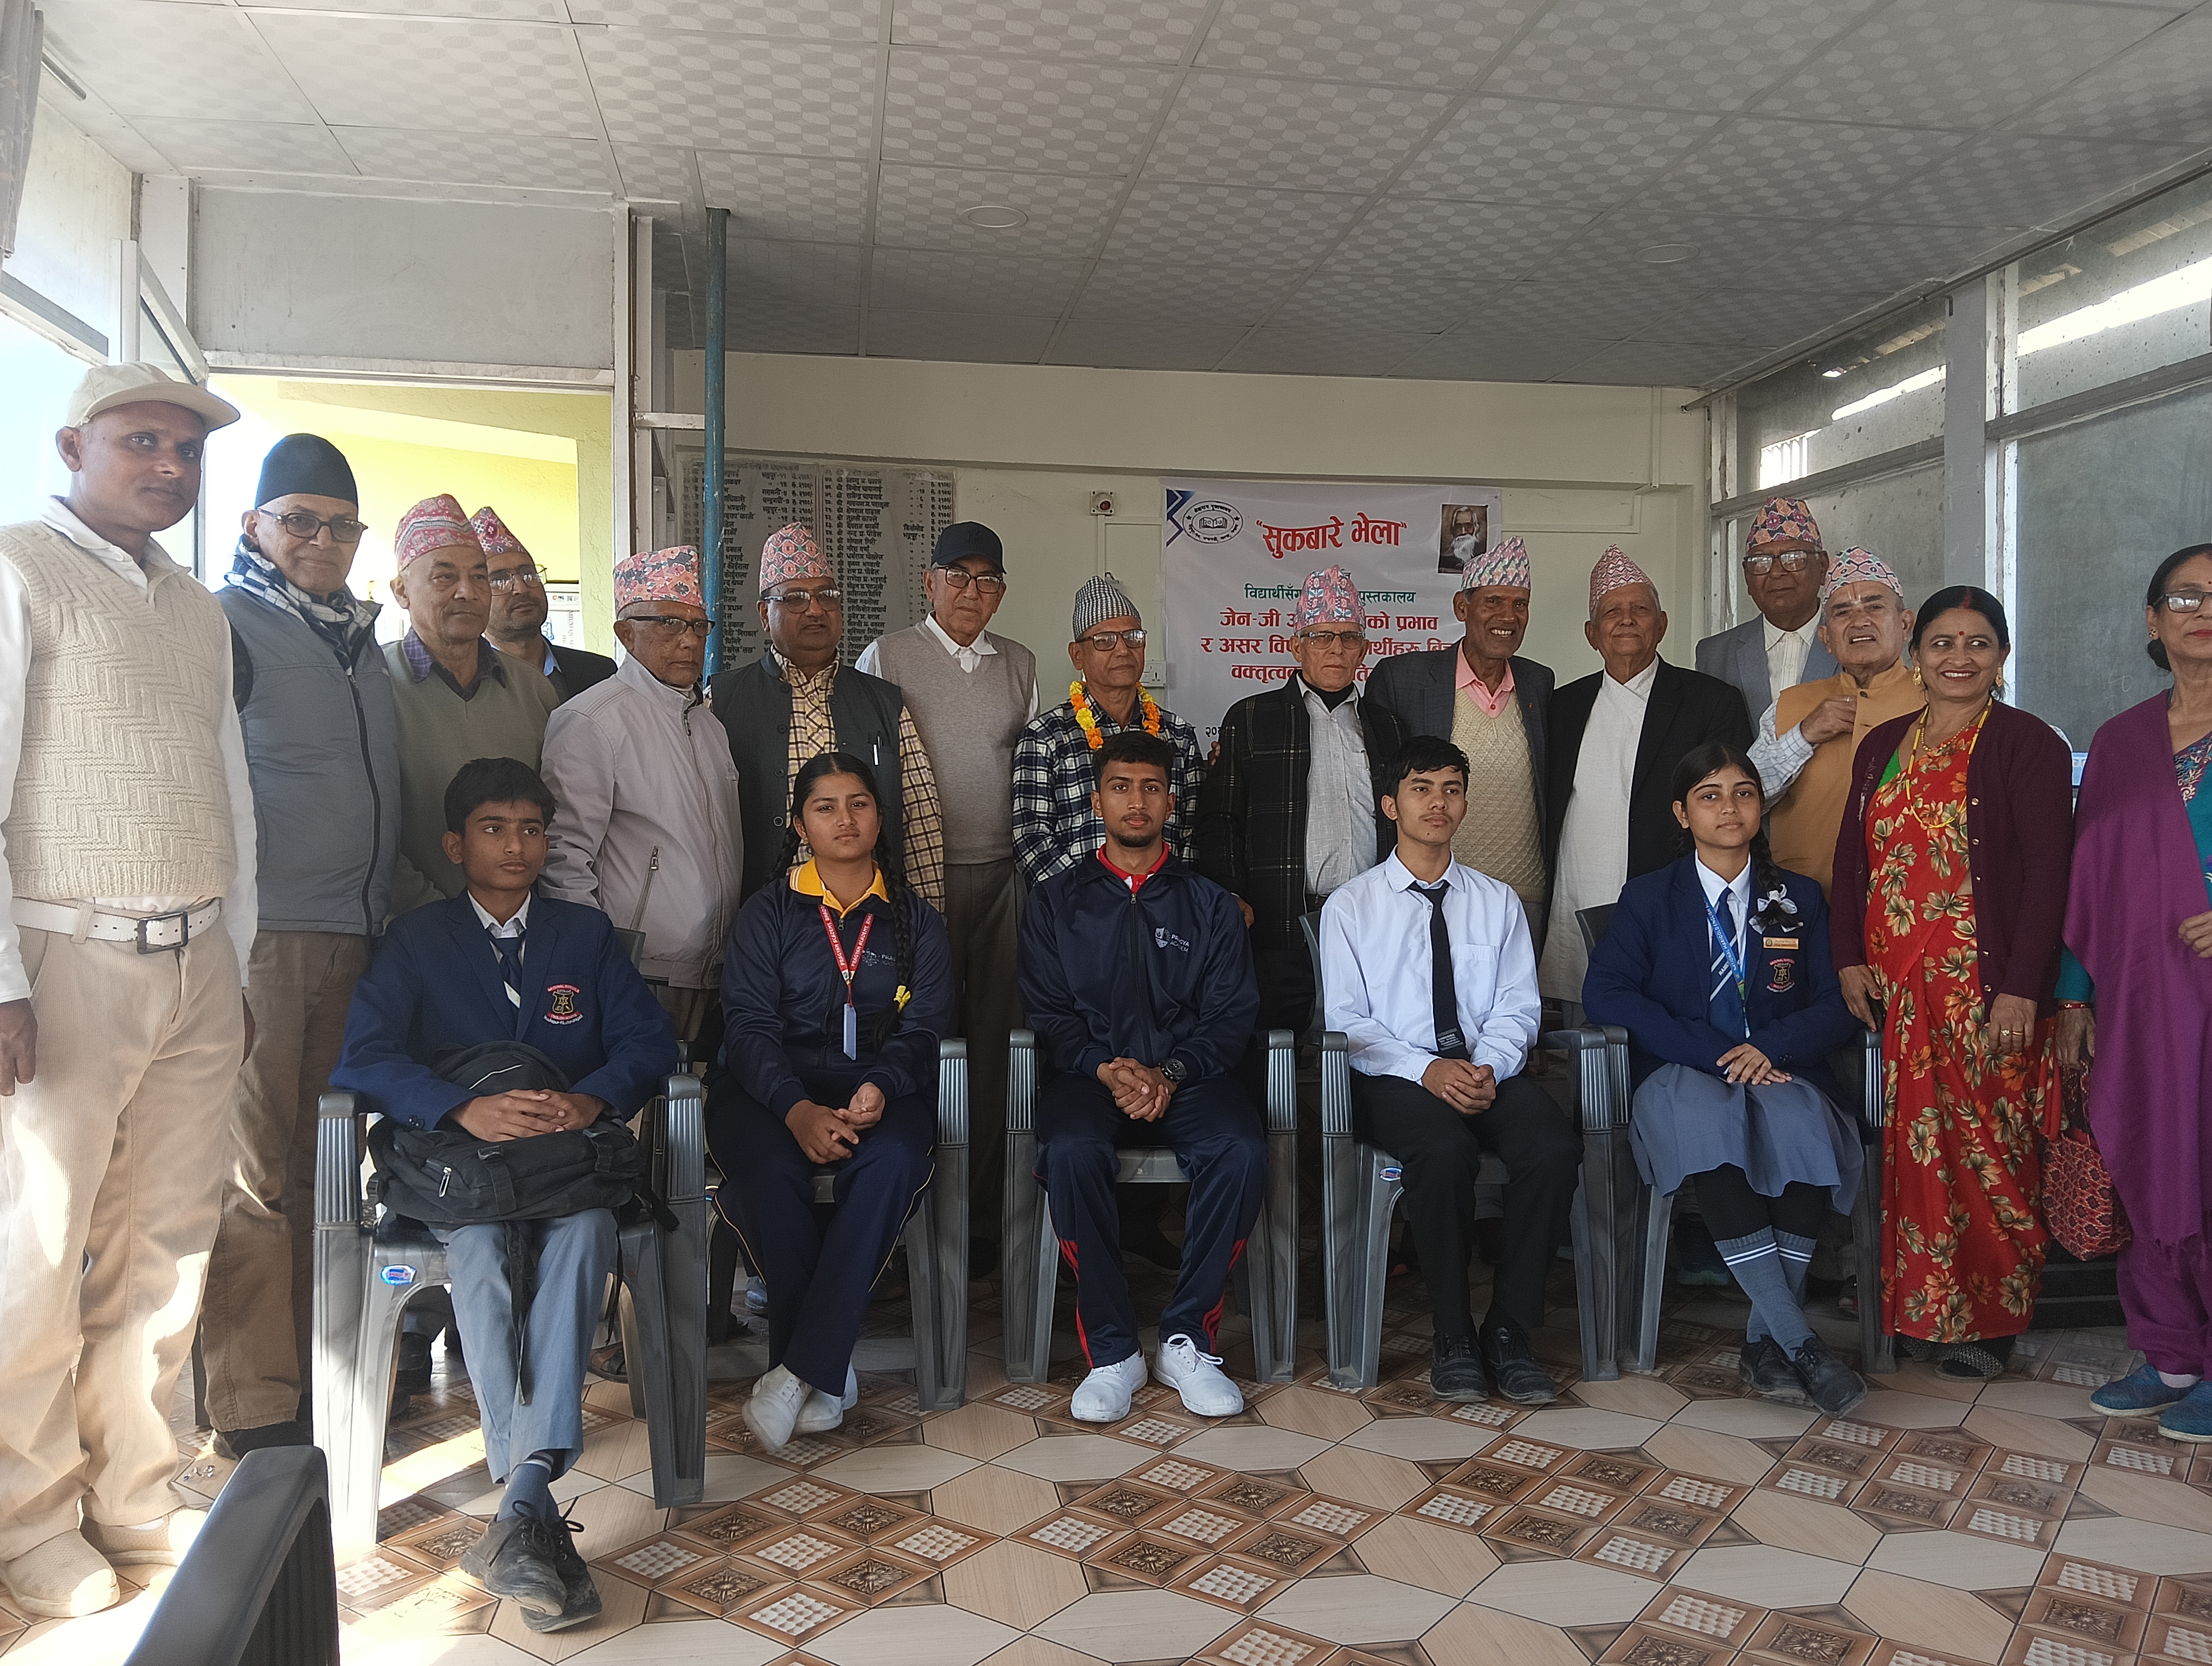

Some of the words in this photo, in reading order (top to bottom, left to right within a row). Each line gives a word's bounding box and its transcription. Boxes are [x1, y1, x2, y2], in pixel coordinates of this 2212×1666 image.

[1396, 616, 1439, 632] प्रभाव
[1200, 637, 1214, 653] र
[1219, 638, 1264, 654] असर
